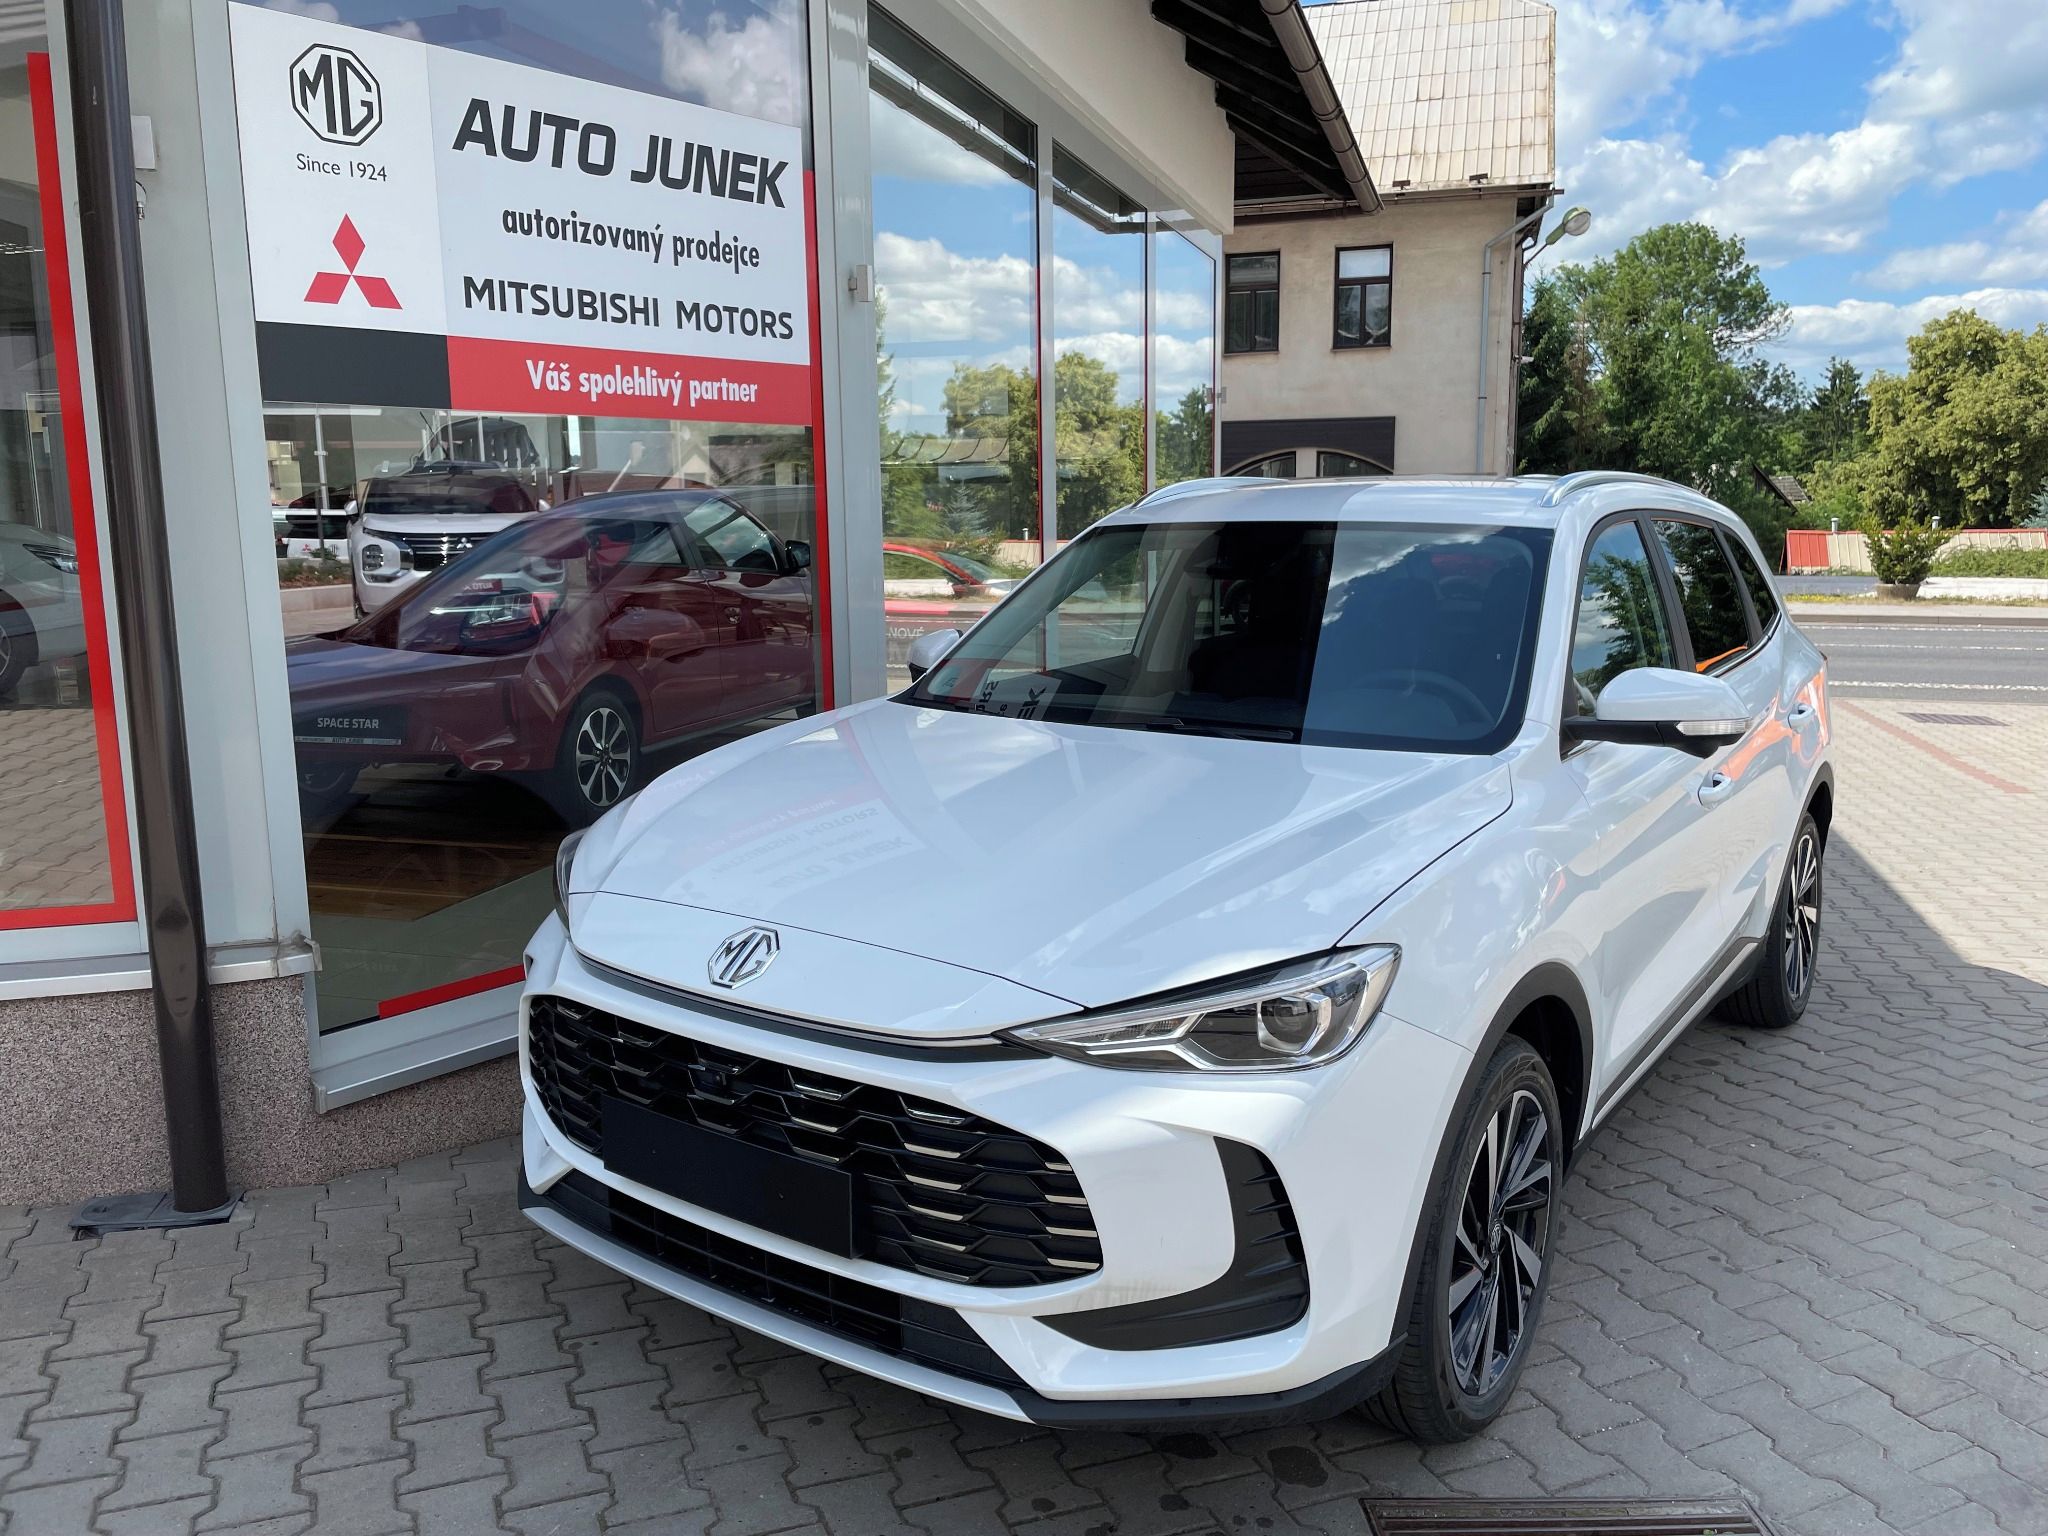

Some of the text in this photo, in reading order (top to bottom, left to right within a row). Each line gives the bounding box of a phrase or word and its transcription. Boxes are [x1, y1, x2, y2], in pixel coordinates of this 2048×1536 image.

[298, 53, 374, 137] MG
[296, 153, 388, 182] Since 1924
[453, 97, 789, 209] AUTO JUNEK
[502, 208, 760, 274] autorizovaný prodejce
[463, 276, 794, 340] MITSUBISHI MOTORS
[527, 360, 758, 407] Váš spolehlivý partner
[317, 718, 380, 729] SPACE STAR
[713, 929, 774, 983] MG
